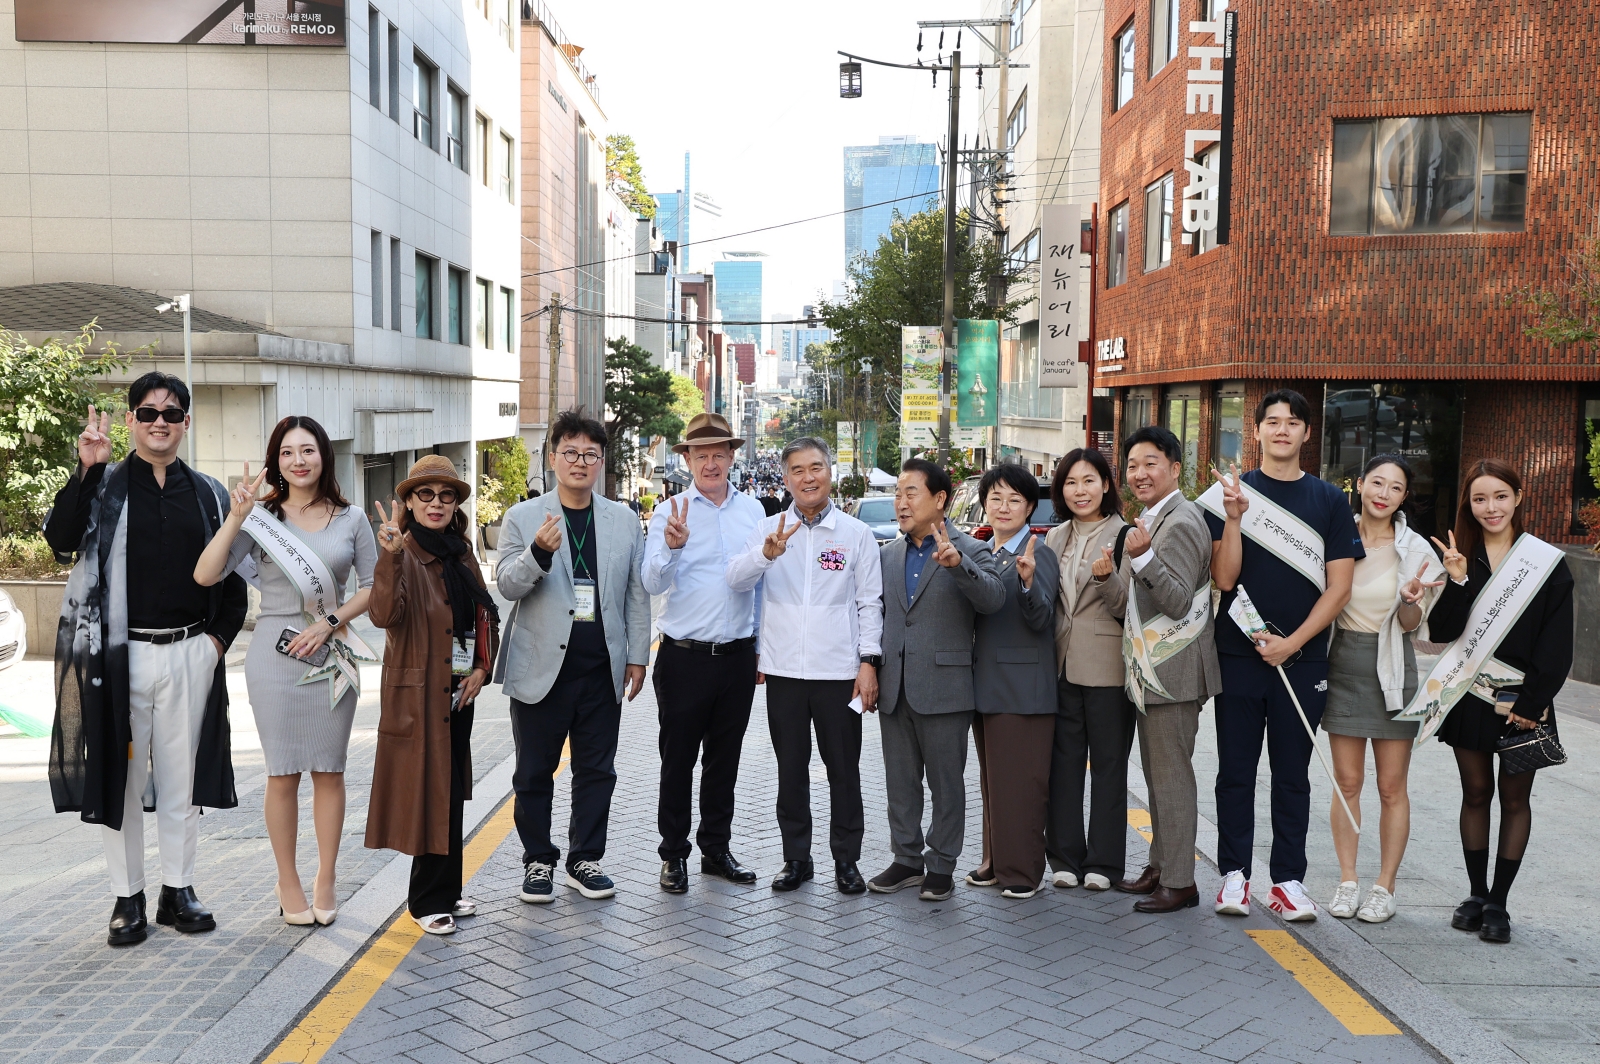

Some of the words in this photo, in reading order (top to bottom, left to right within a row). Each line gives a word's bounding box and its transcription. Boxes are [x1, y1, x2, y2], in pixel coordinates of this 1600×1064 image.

[232, 22, 280, 34] karimoku
[281, 27, 290, 35] by
[290, 24, 336, 34] REMOD
[1186, 10, 1226, 115] THE
[1181, 130, 1221, 245] LAB.
[1048, 244, 1075, 339] 재뉴어리
[1043, 358, 1055, 366] live
[1057, 358, 1075, 367] cafe
[1098, 339, 1110, 361] THE
